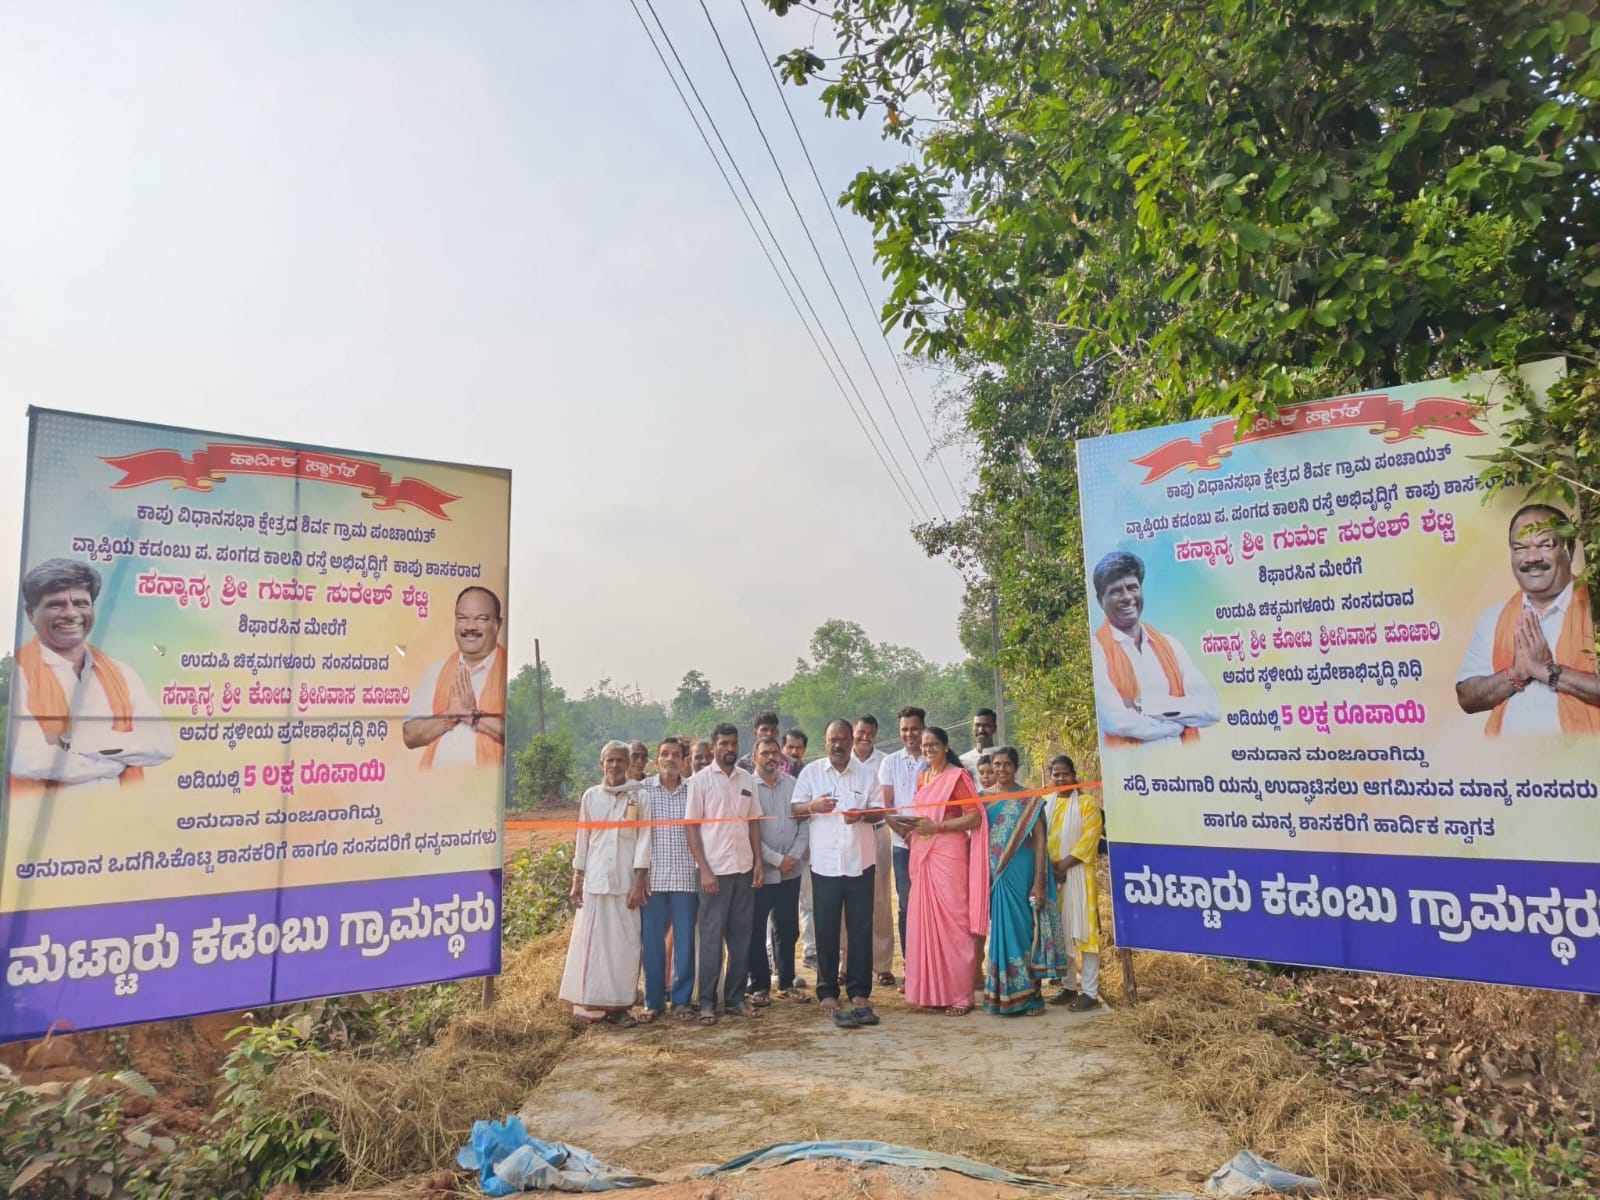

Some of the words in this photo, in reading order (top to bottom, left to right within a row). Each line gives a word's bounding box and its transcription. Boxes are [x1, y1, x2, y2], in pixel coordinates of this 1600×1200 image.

[1166, 482, 1194, 499] ಕಾಪು
[1197, 473, 1261, 497] ವಿಧಾನಸಭಾ
[1264, 466, 1299, 490] ಕ್ಷೇತ್ರದ
[1304, 462, 1332, 480] ಶಿರ್ವ
[1336, 455, 1371, 479] ಗ್ರಾಮ
[1375, 444, 1452, 471] ಪಂಚಾಯತ್
[137, 504, 174, 525] ಕಾಪು
[178, 507, 255, 531] ವಿಧಾನಸಭಾ
[258, 512, 298, 536] ಕ್ಷೇತ್ರದ
[301, 515, 331, 535] ಶಿರ್ವ
[334, 521, 367, 541] ಗ್ರಾಮ
[370, 525, 436, 543] ಪಂಚಾಯತ್
[1126, 515, 1169, 539] ವ್ಯಾಪ್ತಿಯ
[1172, 510, 1211, 529] ಕಡಂಬು
[1215, 507, 1229, 523] ಪ.
[1232, 501, 1269, 520] ಪಂಗಡ
[1272, 498, 1309, 516] ಕಾಲನಿ
[1312, 491, 1335, 517] ರಸ್ತೆ
[1336, 484, 1398, 512] ಅಭಿವೃದ್ಧಿಗೆ
[1405, 480, 1440, 499] ಕಾಪು
[1176, 534, 1234, 568] ಸನ್ಮಾನ್ಯ
[1240, 529, 1264, 562] ಶ್ರೀ
[1273, 524, 1327, 550] ಗುರ್ಮೆ
[1338, 512, 1410, 543] ಸುರೇಶ್
[1421, 509, 1456, 543] ಶೆಟ್ಟಿ
[72, 536, 135, 564] ವ್ಯಾಪ್ತಿಯ
[139, 539, 191, 559] ಕಡಂಬು
[195, 544, 212, 560] ಪ.
[216, 545, 260, 563] ಪಂಗಡ
[263, 550, 302, 567] ಕಾಲನಿ
[306, 550, 328, 574] ರಸ್ತೆ
[330, 554, 388, 580] ಅಭಿವೃದ್ಧಿಗೆ
[393, 559, 422, 578] ಕಾಪು
[426, 561, 481, 578] ಶಾಸಕರಾದ
[1319, 556, 1362, 578] ಮೇರೆಗೆ
[138, 571, 211, 609] ಸನ್ಮಾನ್ಯ
[220, 575, 249, 606] ಶ್ರೀ
[258, 577, 316, 601] ಗುರ್ಮೆ
[326, 581, 393, 605] ಸುರೇಶ್
[402, 586, 429, 618] ಶೆಟ್ಟಿ
[1216, 600, 1257, 619] ಉಡುಪಿ
[1258, 597, 1335, 622] ಚಿಕ್ಕಮಗಳೂರು
[1341, 589, 1414, 611] ಸಂಸದರಾದ
[304, 617, 347, 636] ಮೇರೆಗೆ
[1203, 633, 1245, 662] ಸನ್ಮಾನ್ಯ
[1250, 629, 1266, 657] ಶ್ರೀ
[1273, 627, 1313, 650] ಕೋಟ
[1319, 624, 1378, 654] ಶ್ರೀನಿವಾಸ
[1384, 621, 1441, 644] ಪೂಜಾರಿ
[181, 652, 231, 670] ಉಡುಪಿ
[232, 653, 316, 676] ಚಿಕ್ಕಮಗಳೂರು
[321, 654, 389, 672] ಸಂಸದರಾದ
[1222, 668, 1255, 684] ಅವರ
[1258, 665, 1303, 692] ಸ್ಥಳೀಯ
[1307, 661, 1398, 688] ಪ್ರದೇಶಾಭಿವೃದ್ಧಿ
[1399, 659, 1422, 682] ನಿಧಿ
[163, 682, 215, 716] ಸನ್ಮಾನ್ಯ
[221, 682, 241, 713] ಶ್ರೀ
[249, 681, 292, 705] ಕೋಟ
[298, 682, 356, 712] ಶ್ರೀನಿವಾಸ
[362, 684, 410, 705] ಪೂಜಾರಿ
[1227, 709, 1281, 731] ಅಡಿಯಲ್ಲಿ
[1281, 705, 1293, 725] 5
[1298, 701, 1331, 734] ಲಕ್ಷ
[1334, 699, 1426, 726] ರೂಪಾಯಿ
[179, 723, 219, 741] ಅವರ
[222, 723, 273, 750] ಸ್ಥಳೀಯ
[278, 720, 365, 747] ಪ್ರದೇಶಾಭಿವೃದ್ಧಿ
[367, 720, 388, 741] ನಿಧಿ
[1231, 747, 1301, 762] ಅನುದಾನ
[1306, 746, 1429, 768] ಮಂಜೂರಾಗಿದ್ದು
[177, 770, 241, 794] ಅಡಿಯಲ್ಲಿ
[243, 765, 256, 787] 5
[262, 759, 295, 794] ಲಕ್ಷ
[300, 758, 386, 785] ರೂಪಾಯಿ
[1124, 775, 1149, 795] ಸದ್ರಿ
[1152, 776, 1214, 793] ಕಾಮಗಾರಿ
[1219, 777, 1263, 801] ಯನ್ನು
[1363, 778, 1454, 797] ಆಗಮಿಸುವ
[1460, 779, 1512, 807] ಮಾನ್ಯ
[1516, 780, 1598, 799] ಸಂಸದರು
[176, 809, 260, 831] ಅನುದಾನ
[265, 803, 383, 829] ಮಂಜೂರಾಗಿದ್ದು
[1203, 811, 1247, 828] ಹಾಗೂ
[1252, 812, 1296, 837] ಮಾನ್ಯ
[1300, 813, 1369, 832] ಶಾಸಕರಿಗೆ
[1374, 815, 1439, 835] ಹಾರ್ದಿಕ
[1445, 817, 1495, 844] ಸ್ವಾಗತ
[15, 855, 102, 879] ಅನುದಾನ
[107, 846, 215, 875] ಒದಗಿಸಿಕೊಟ್ಟ
[217, 840, 288, 865] ಶಾಸಕರಿಗೆ
[291, 842, 338, 860] ಹಾಗೂ
[342, 833, 411, 857] ಸಂಸದರಿಗೆ
[414, 828, 497, 857] ಧನ್ಯವಾದಗಳು
[1124, 865, 1251, 929] ಮಟ್ಟಾರು
[1261, 873, 1397, 923] ಕಡಂಬು
[6, 923, 180, 996] ಮಟ್ಟಾರು
[191, 909, 329, 965] ಕಡಂಬು
[339, 891, 497, 959] ಗ್ರಾಮಸ್ಥರು
